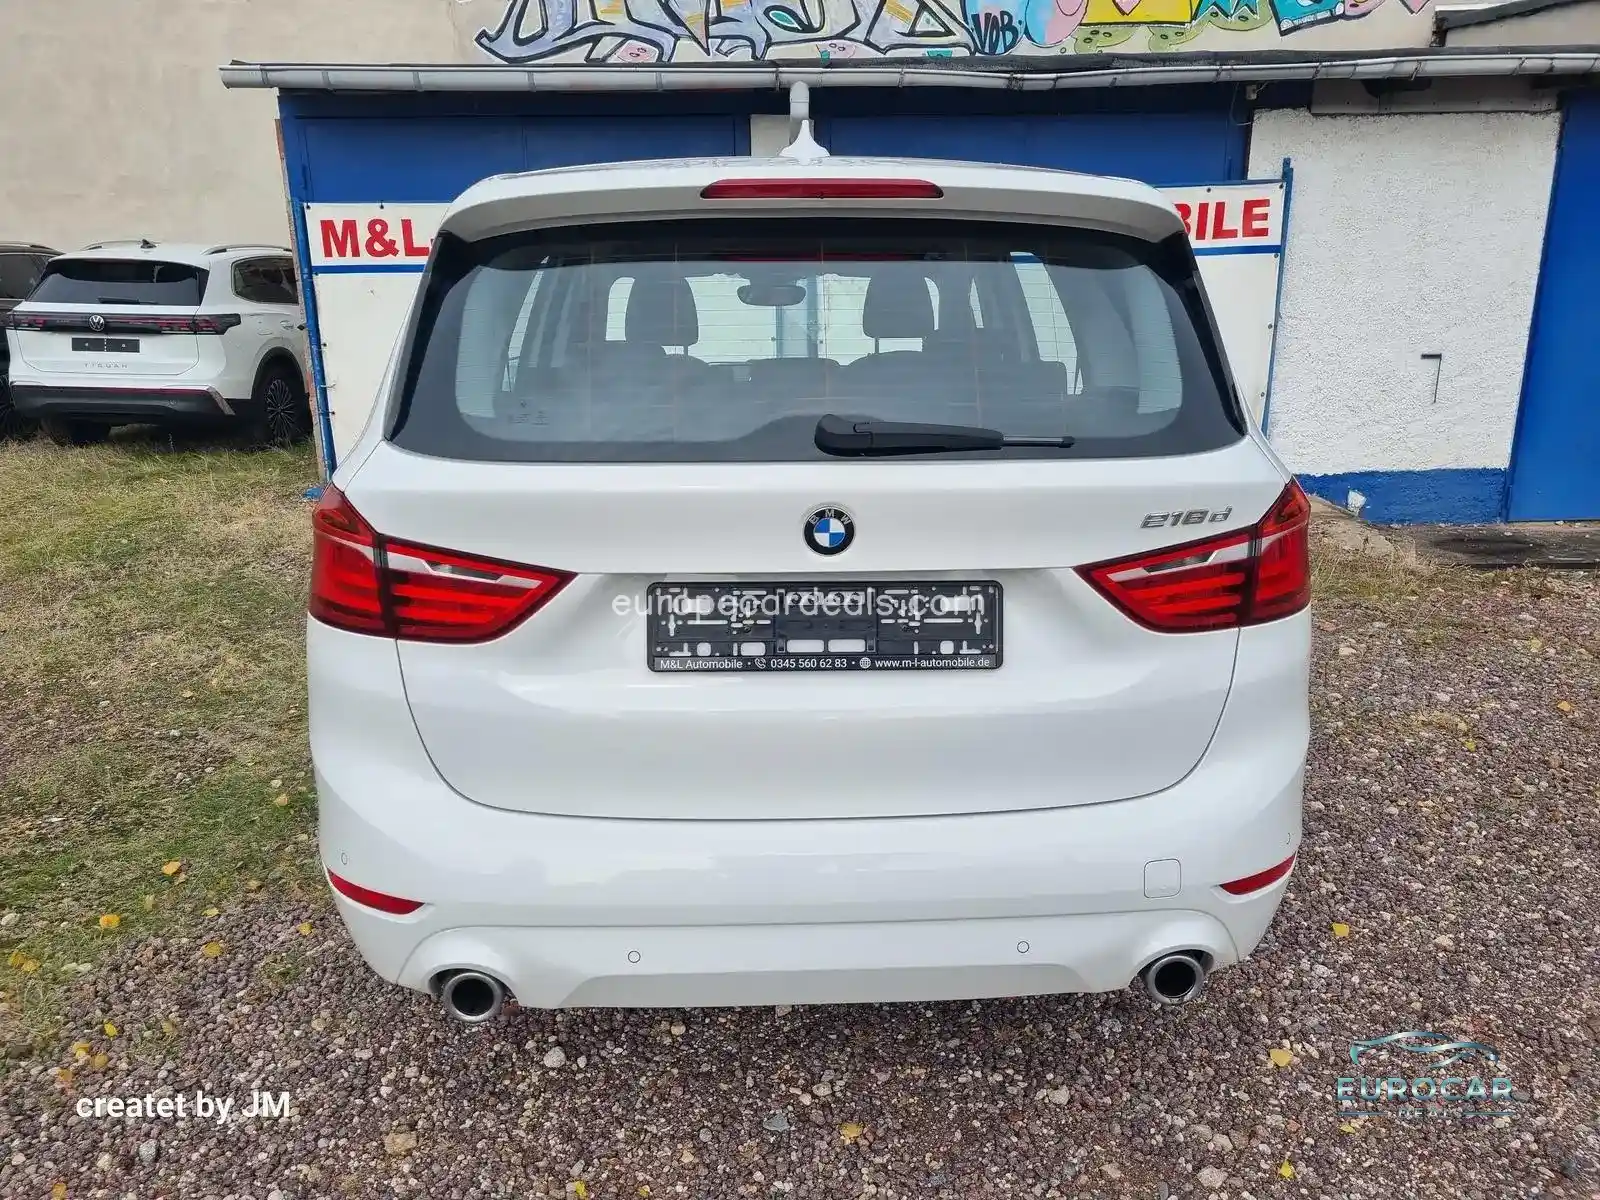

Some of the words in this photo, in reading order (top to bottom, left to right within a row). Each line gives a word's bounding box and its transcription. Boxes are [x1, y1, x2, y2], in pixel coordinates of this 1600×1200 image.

[320, 218, 429, 257] M&L
[809, 509, 851, 525] BMW
[660, 659, 683, 669] M&L
[686, 658, 743, 669] Automobile
[770, 658, 796, 668] 0345
[799, 658, 817, 668] 560
[819, 658, 832, 668] 62
[834, 658, 847, 668] 83
[875, 657, 990, 668] www.m-l-automobile.de
